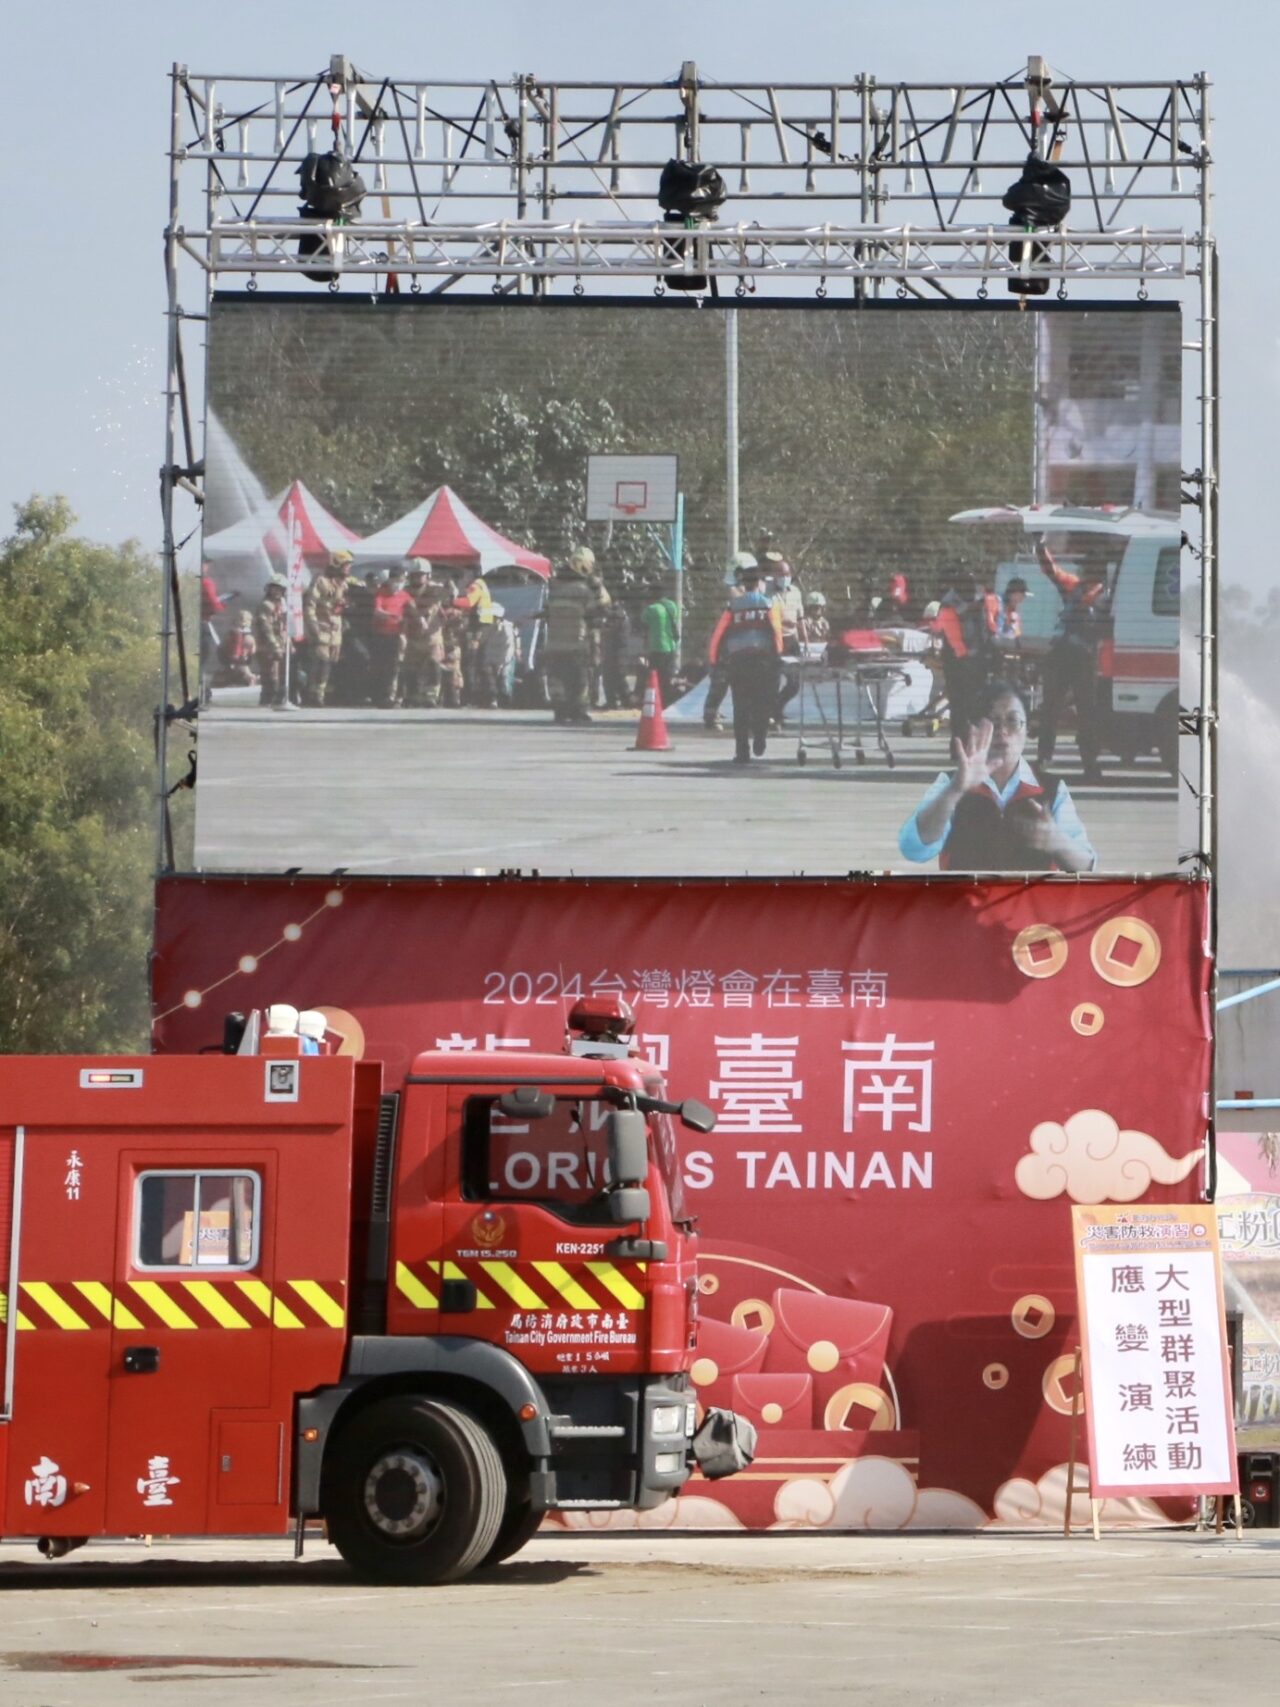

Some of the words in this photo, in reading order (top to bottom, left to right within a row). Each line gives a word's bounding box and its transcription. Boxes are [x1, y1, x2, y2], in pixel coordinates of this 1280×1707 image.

[483, 968, 889, 1008] 2024台灣燈會在臺南
[64, 1150, 83, 1200] 永康11
[737, 1151, 933, 1189] TAINAN
[505, 1331, 528, 1343] Tainan
[530, 1331, 545, 1346] City
[547, 1331, 593, 1344] Government
[594, 1331, 608, 1344] Fire
[609, 1331, 636, 1344] Bureau
[1111, 1264, 1158, 1472] 應變演練
[1155, 1263, 1203, 1472] 大型群聚活動
